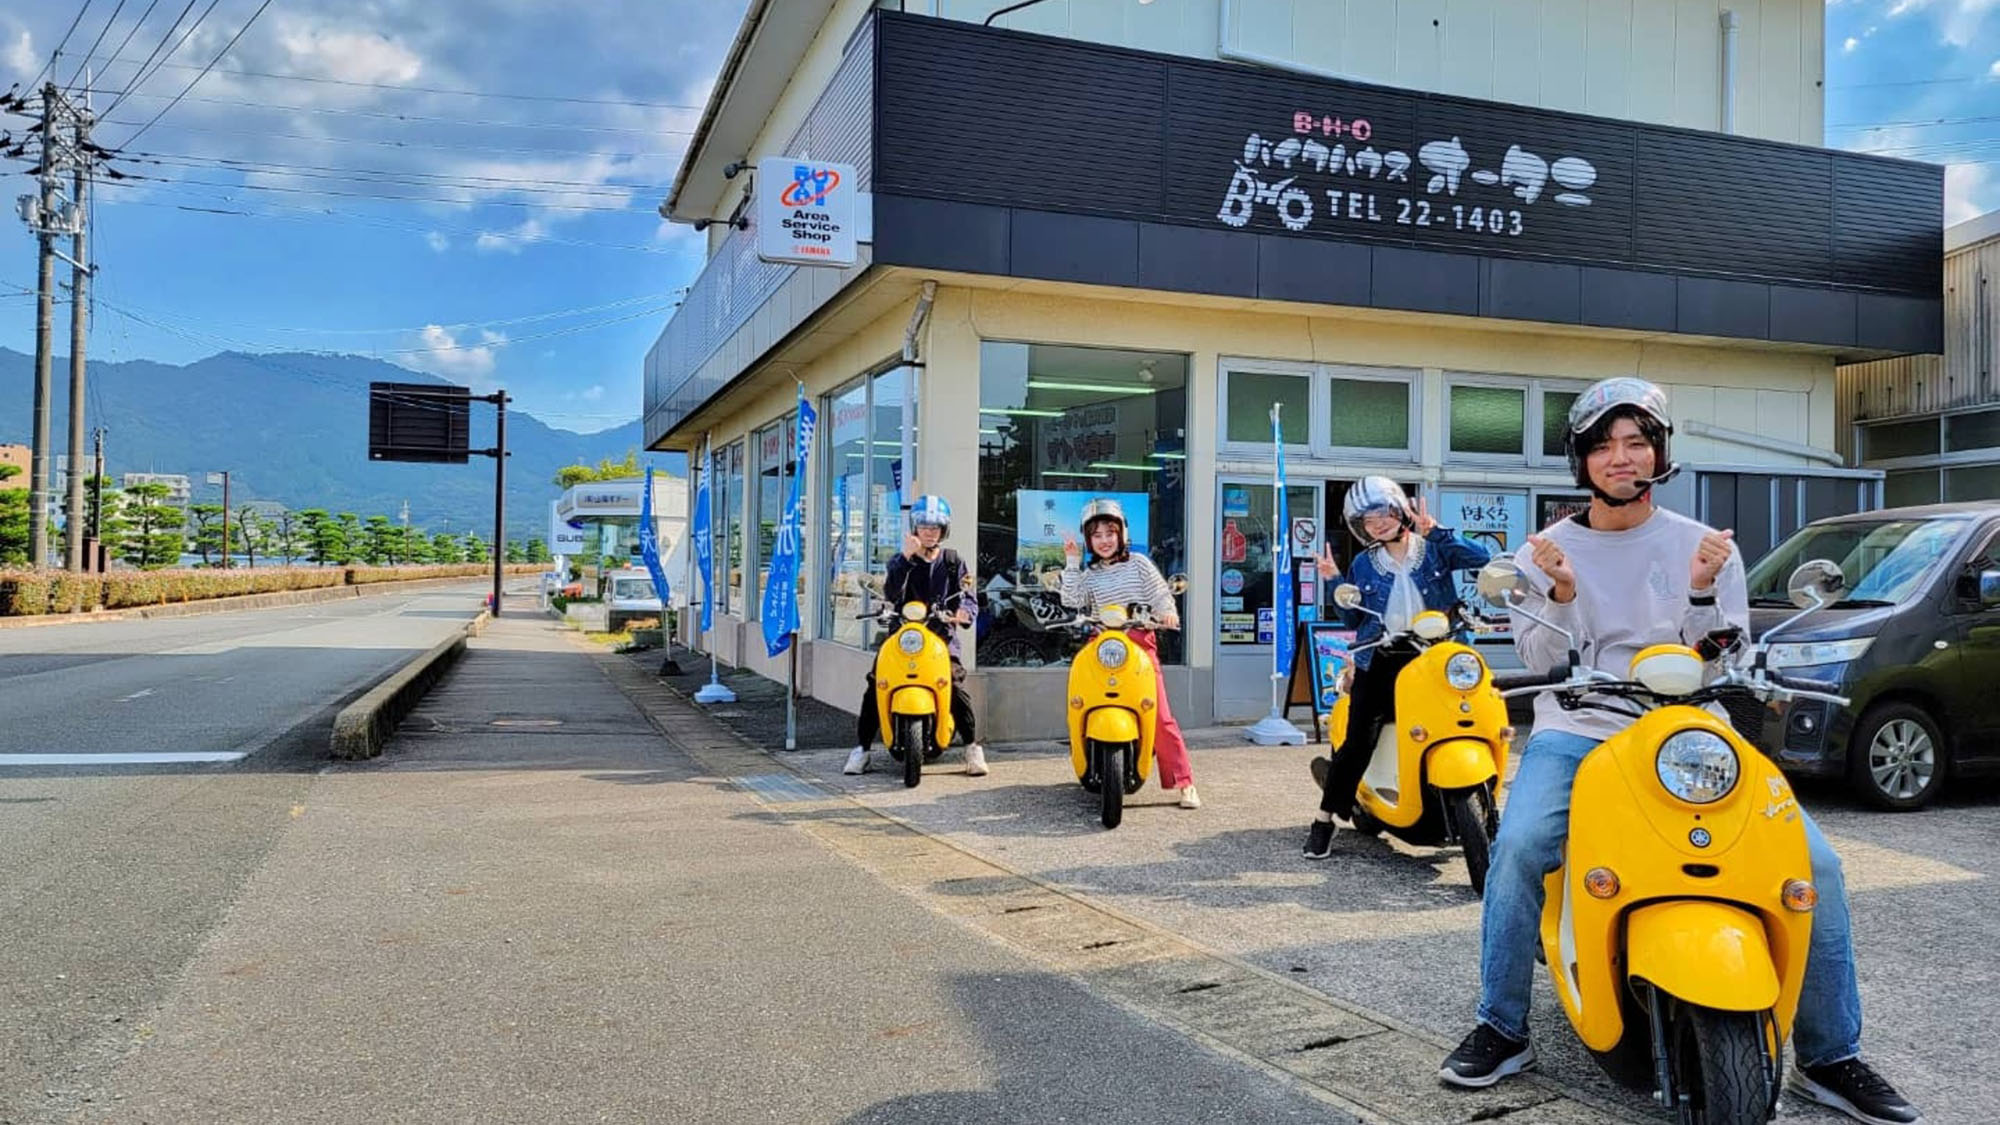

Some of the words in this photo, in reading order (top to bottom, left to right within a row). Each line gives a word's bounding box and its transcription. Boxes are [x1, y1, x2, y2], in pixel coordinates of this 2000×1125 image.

[1243, 132, 1412, 183] バイクハウス
[1417, 135, 1598, 207] オータニ
[793, 210, 830, 221] Area
[1325, 189, 1382, 222] TEL
[1396, 198, 1524, 237] 22-1403
[781, 219, 840, 232] Service
[792, 230, 831, 242] Shop
[1461, 504, 1510, 522] やまぐち
